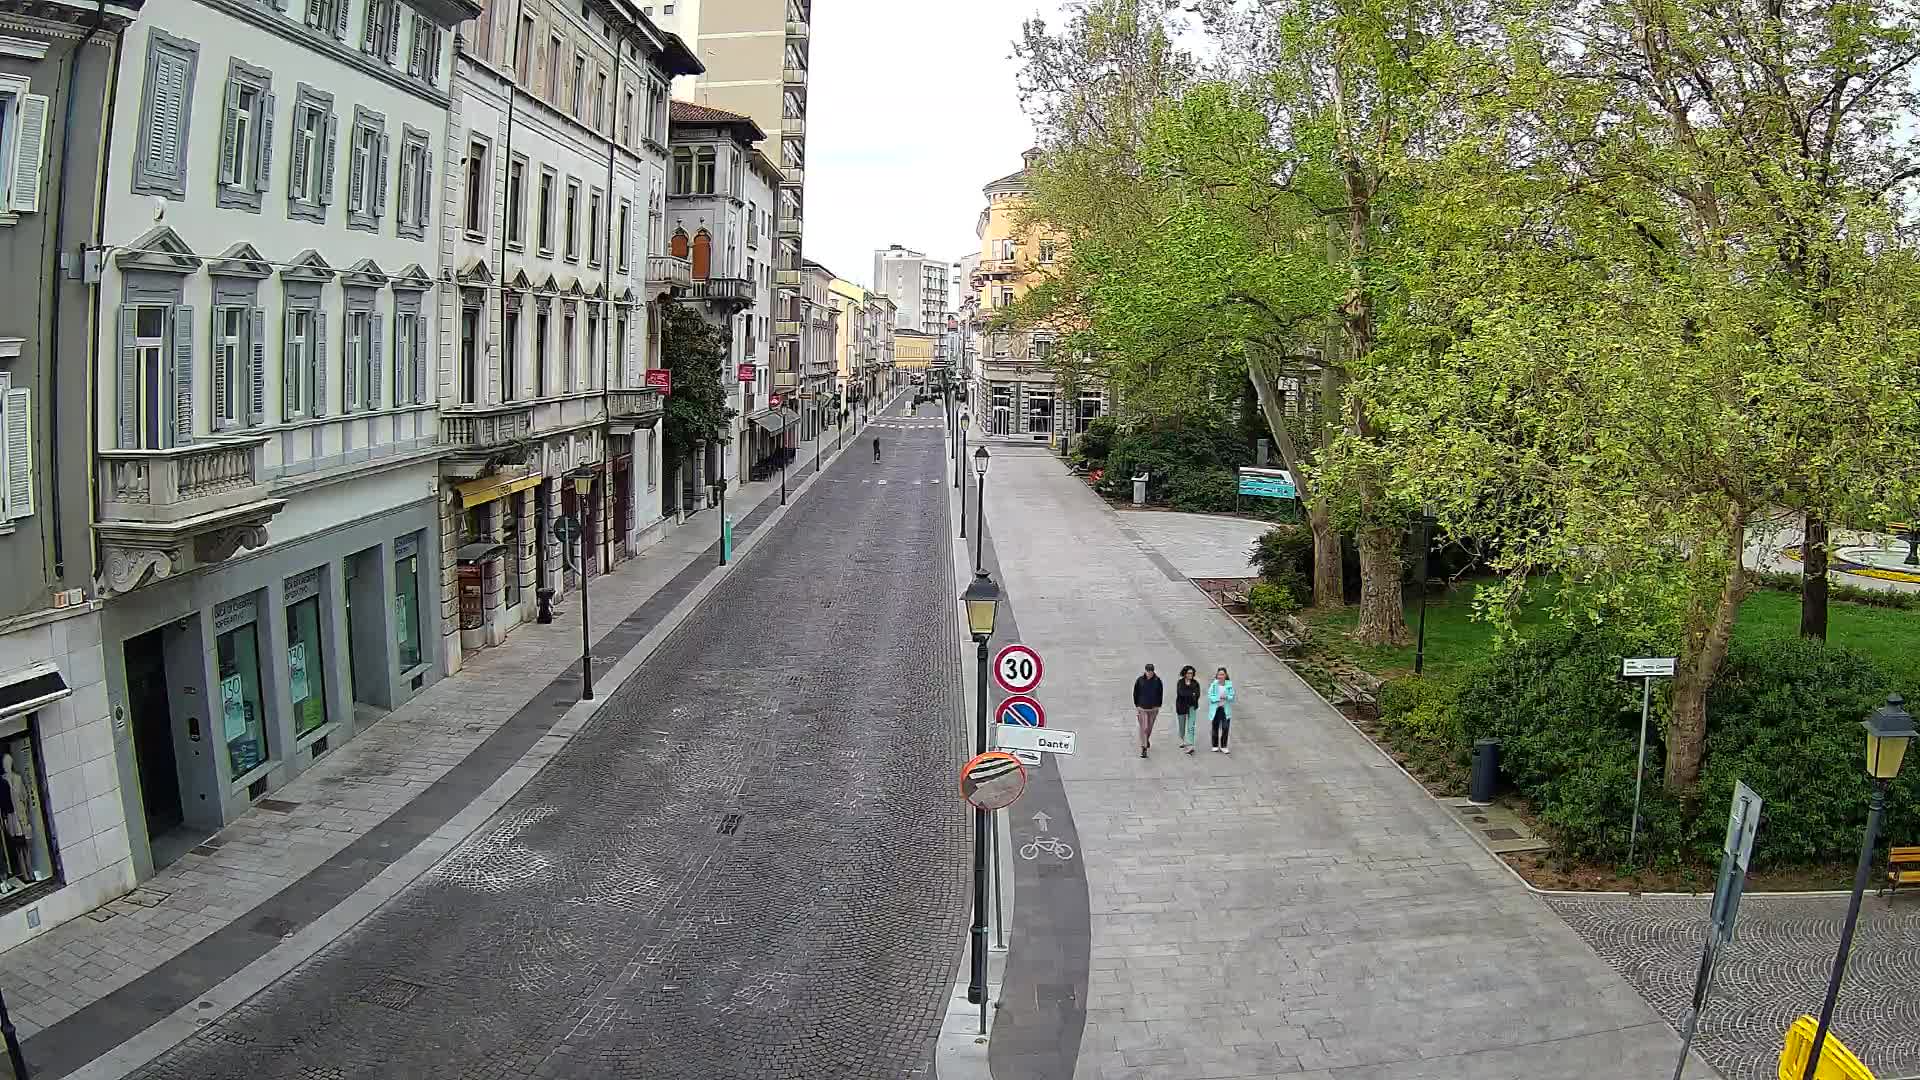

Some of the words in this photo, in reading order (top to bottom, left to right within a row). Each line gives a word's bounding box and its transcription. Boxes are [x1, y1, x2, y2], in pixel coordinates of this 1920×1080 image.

[1005, 658, 1033, 680] 30
[222, 678, 240, 699] 130
[1038, 738, 1070, 749] Dante
